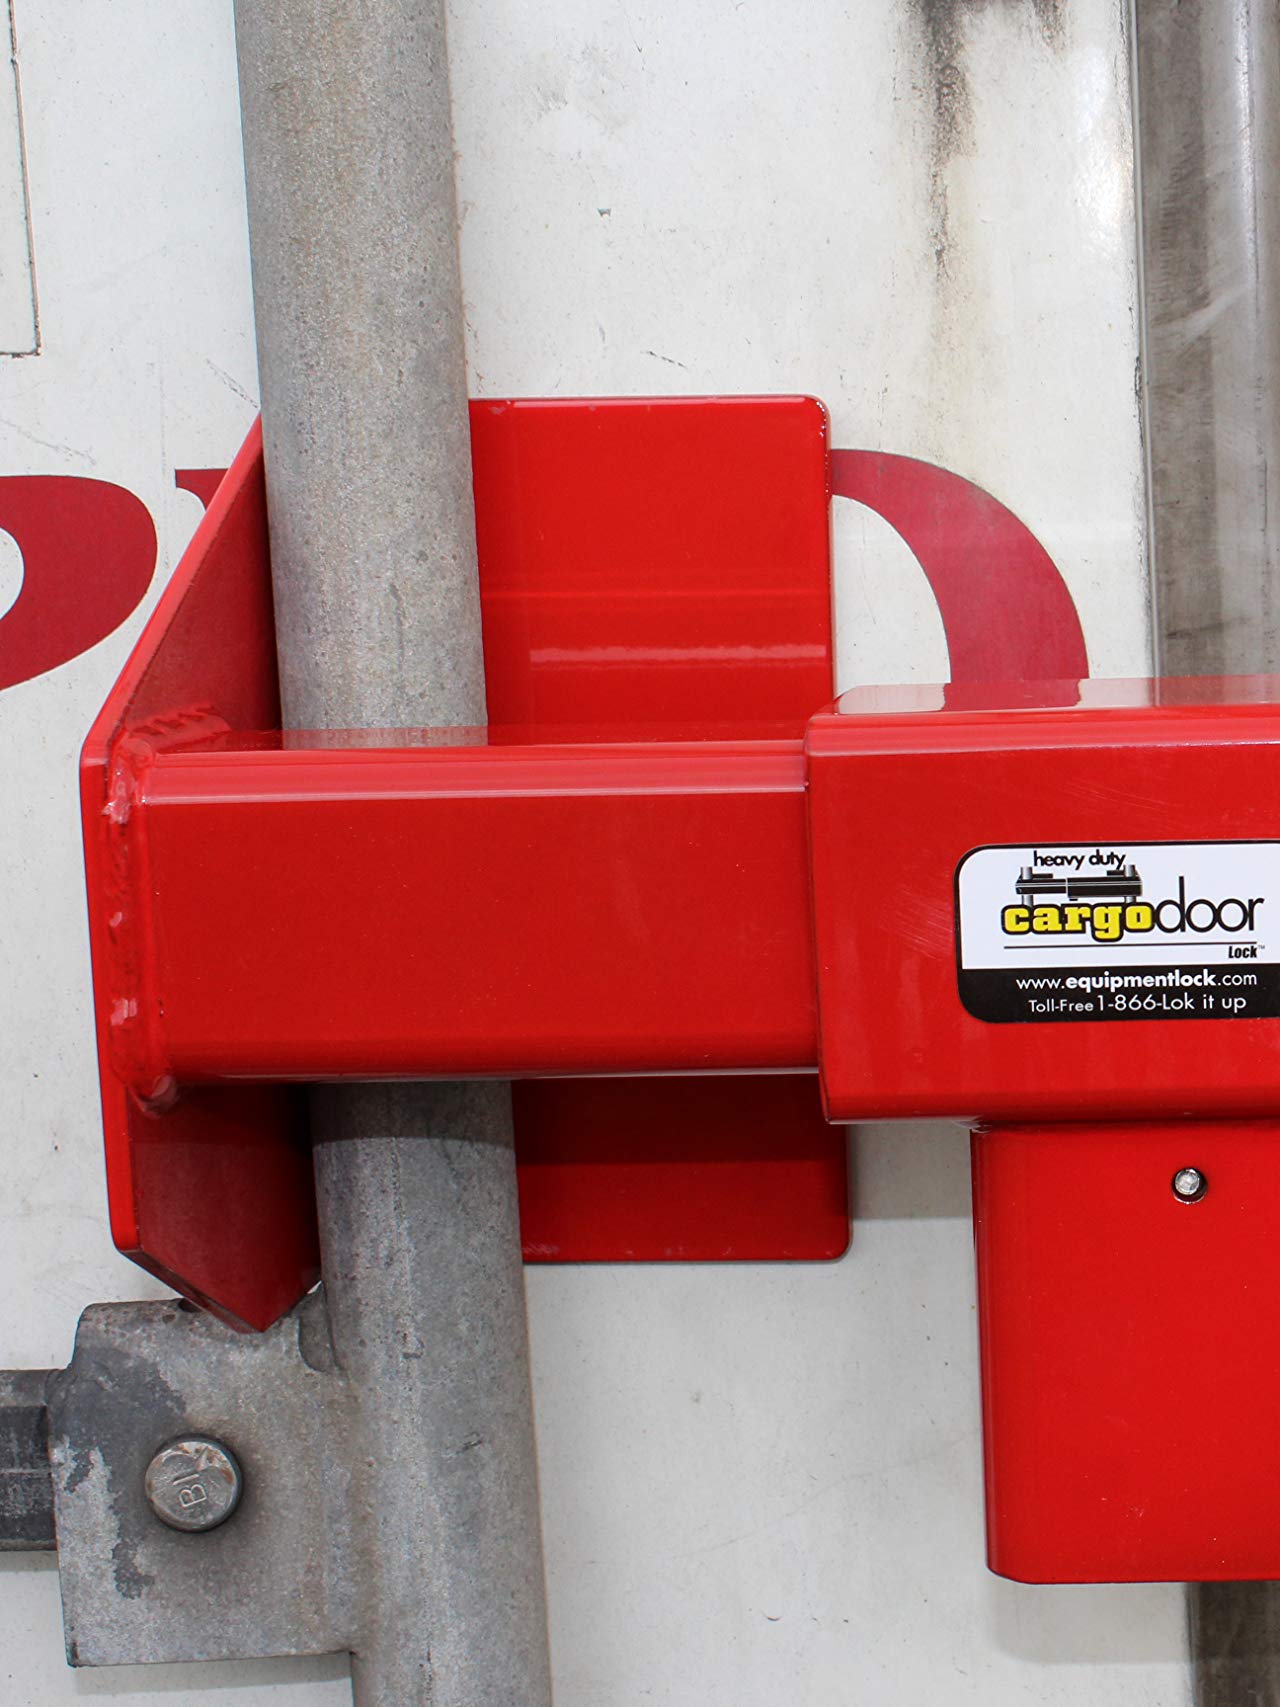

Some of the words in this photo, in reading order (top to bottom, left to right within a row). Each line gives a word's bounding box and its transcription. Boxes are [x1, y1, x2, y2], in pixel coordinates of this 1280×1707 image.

[1034, 851, 1084, 870] heavy
[1089, 850, 1125, 869] duty
[1016, 970, 1257, 992] www.equipmentlock.com
[1029, 999, 1093, 1012] Toll-Free
[1099, 994, 1194, 1012] 1-866-Lok
[1203, 993, 1214, 1009] it
[1222, 996, 1246, 1014] up
